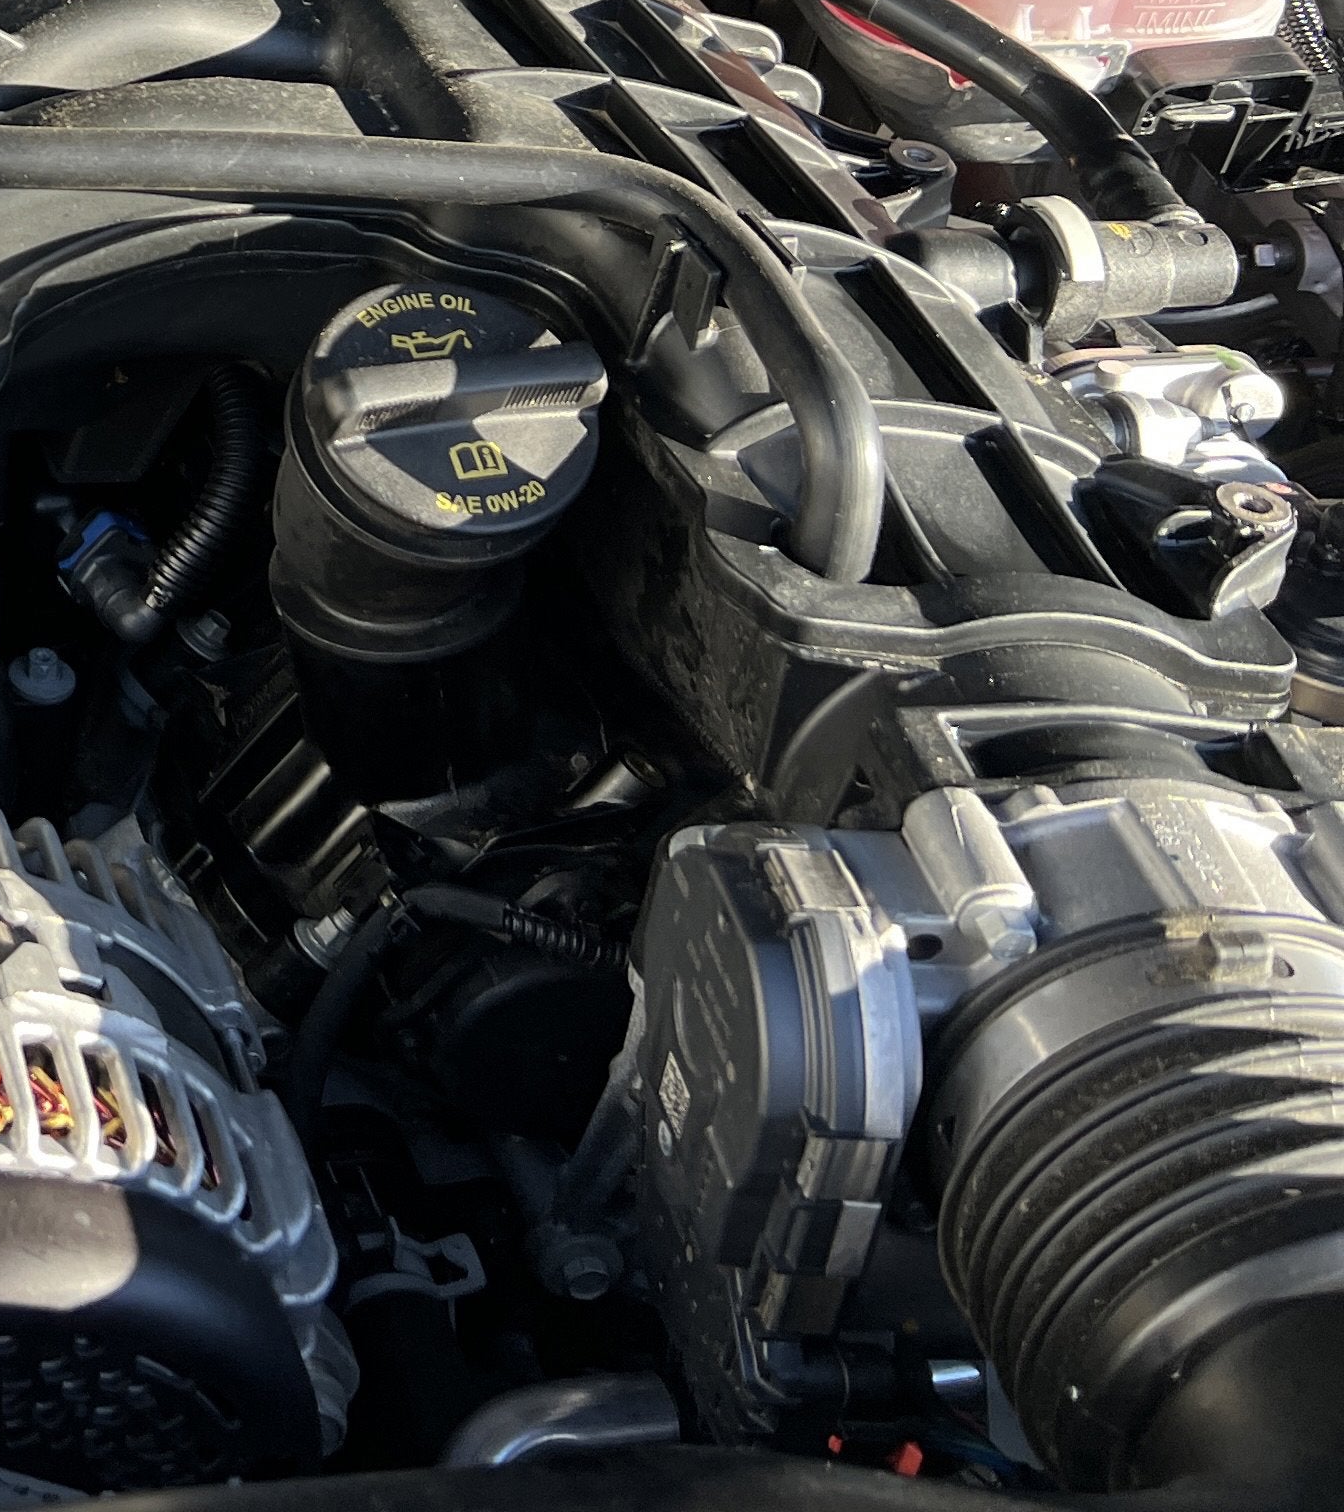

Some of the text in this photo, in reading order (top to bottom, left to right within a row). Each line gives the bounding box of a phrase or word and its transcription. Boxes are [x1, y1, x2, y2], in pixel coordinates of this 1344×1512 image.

[356, 292, 477, 329] ENGINE OIL
[435, 480, 546, 514] SAE 0W-20
